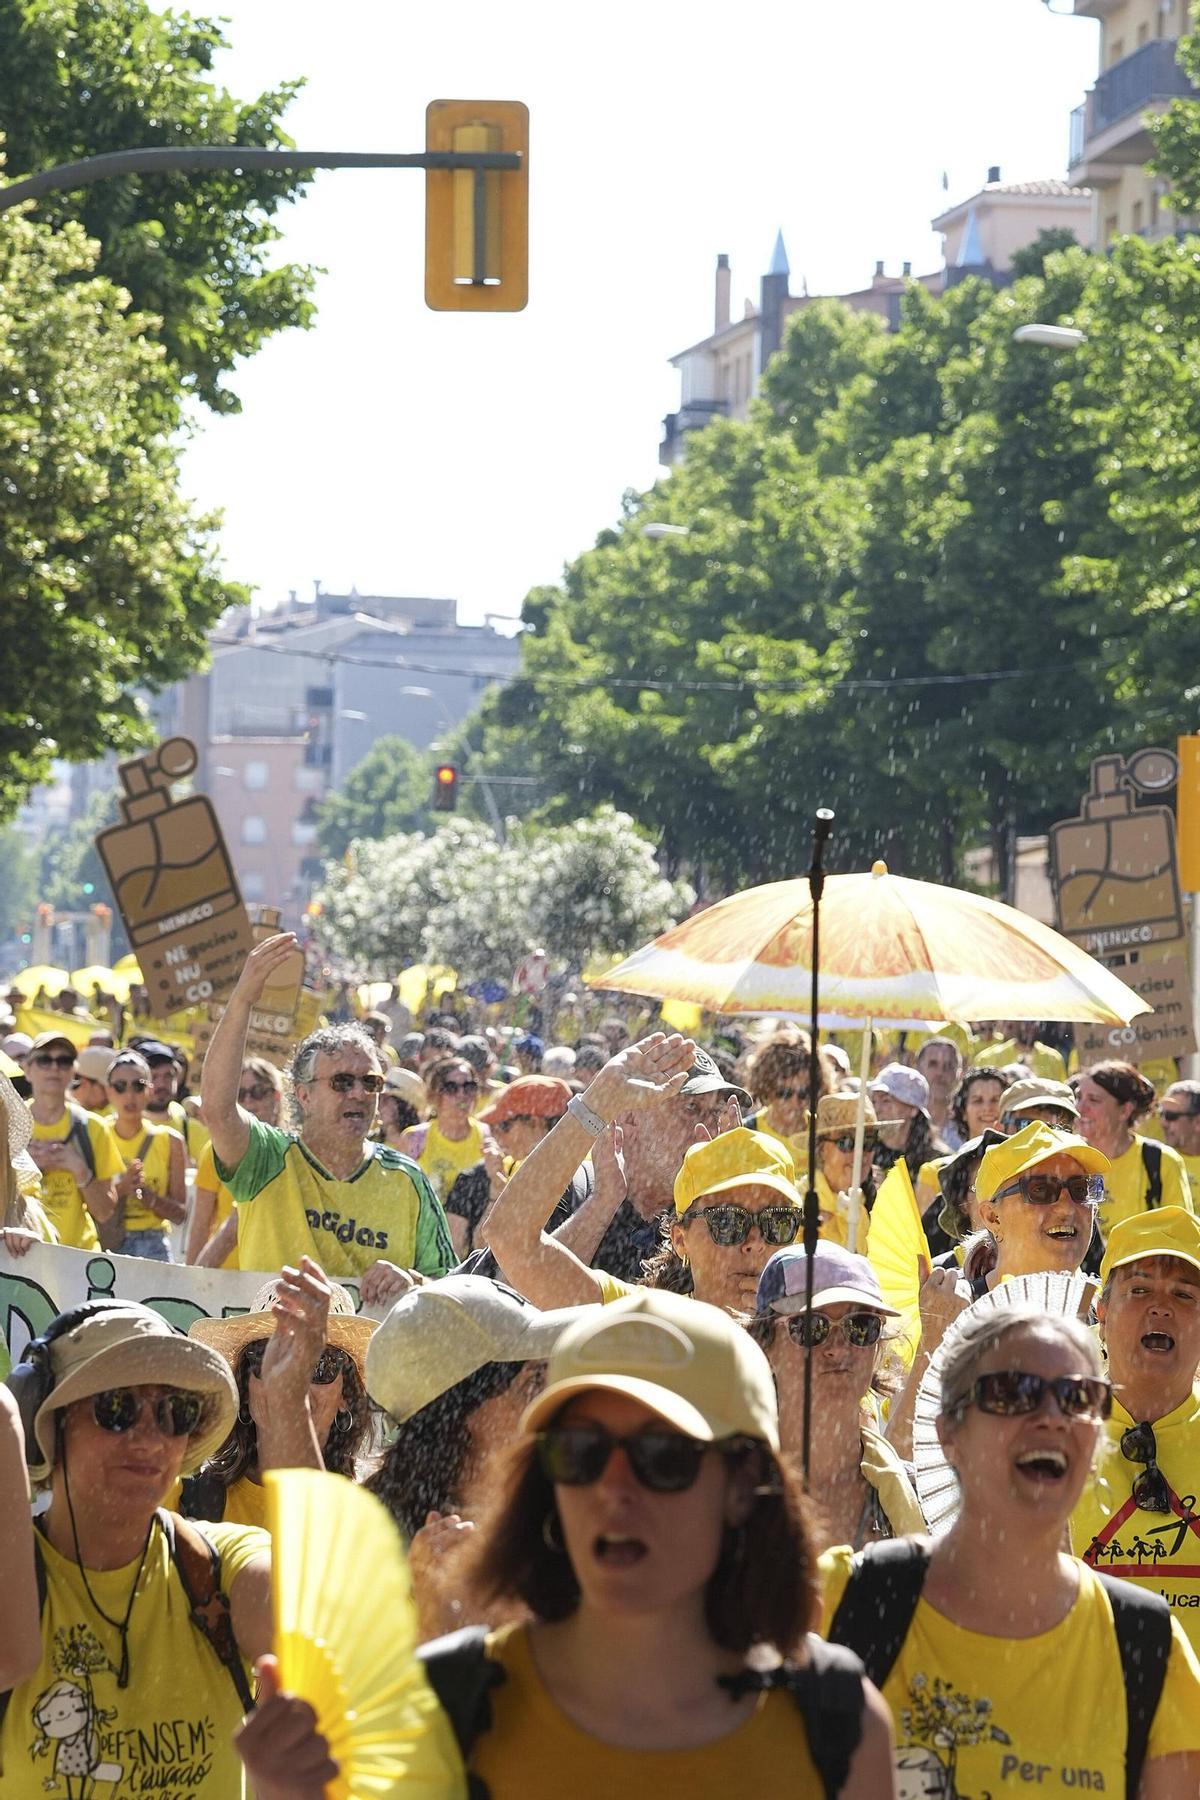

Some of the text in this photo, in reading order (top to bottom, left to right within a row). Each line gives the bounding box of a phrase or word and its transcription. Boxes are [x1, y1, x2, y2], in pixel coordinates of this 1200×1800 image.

[101, 1720, 206, 1767] DEFENSEM
[1001, 1754, 1104, 1792] Per una
